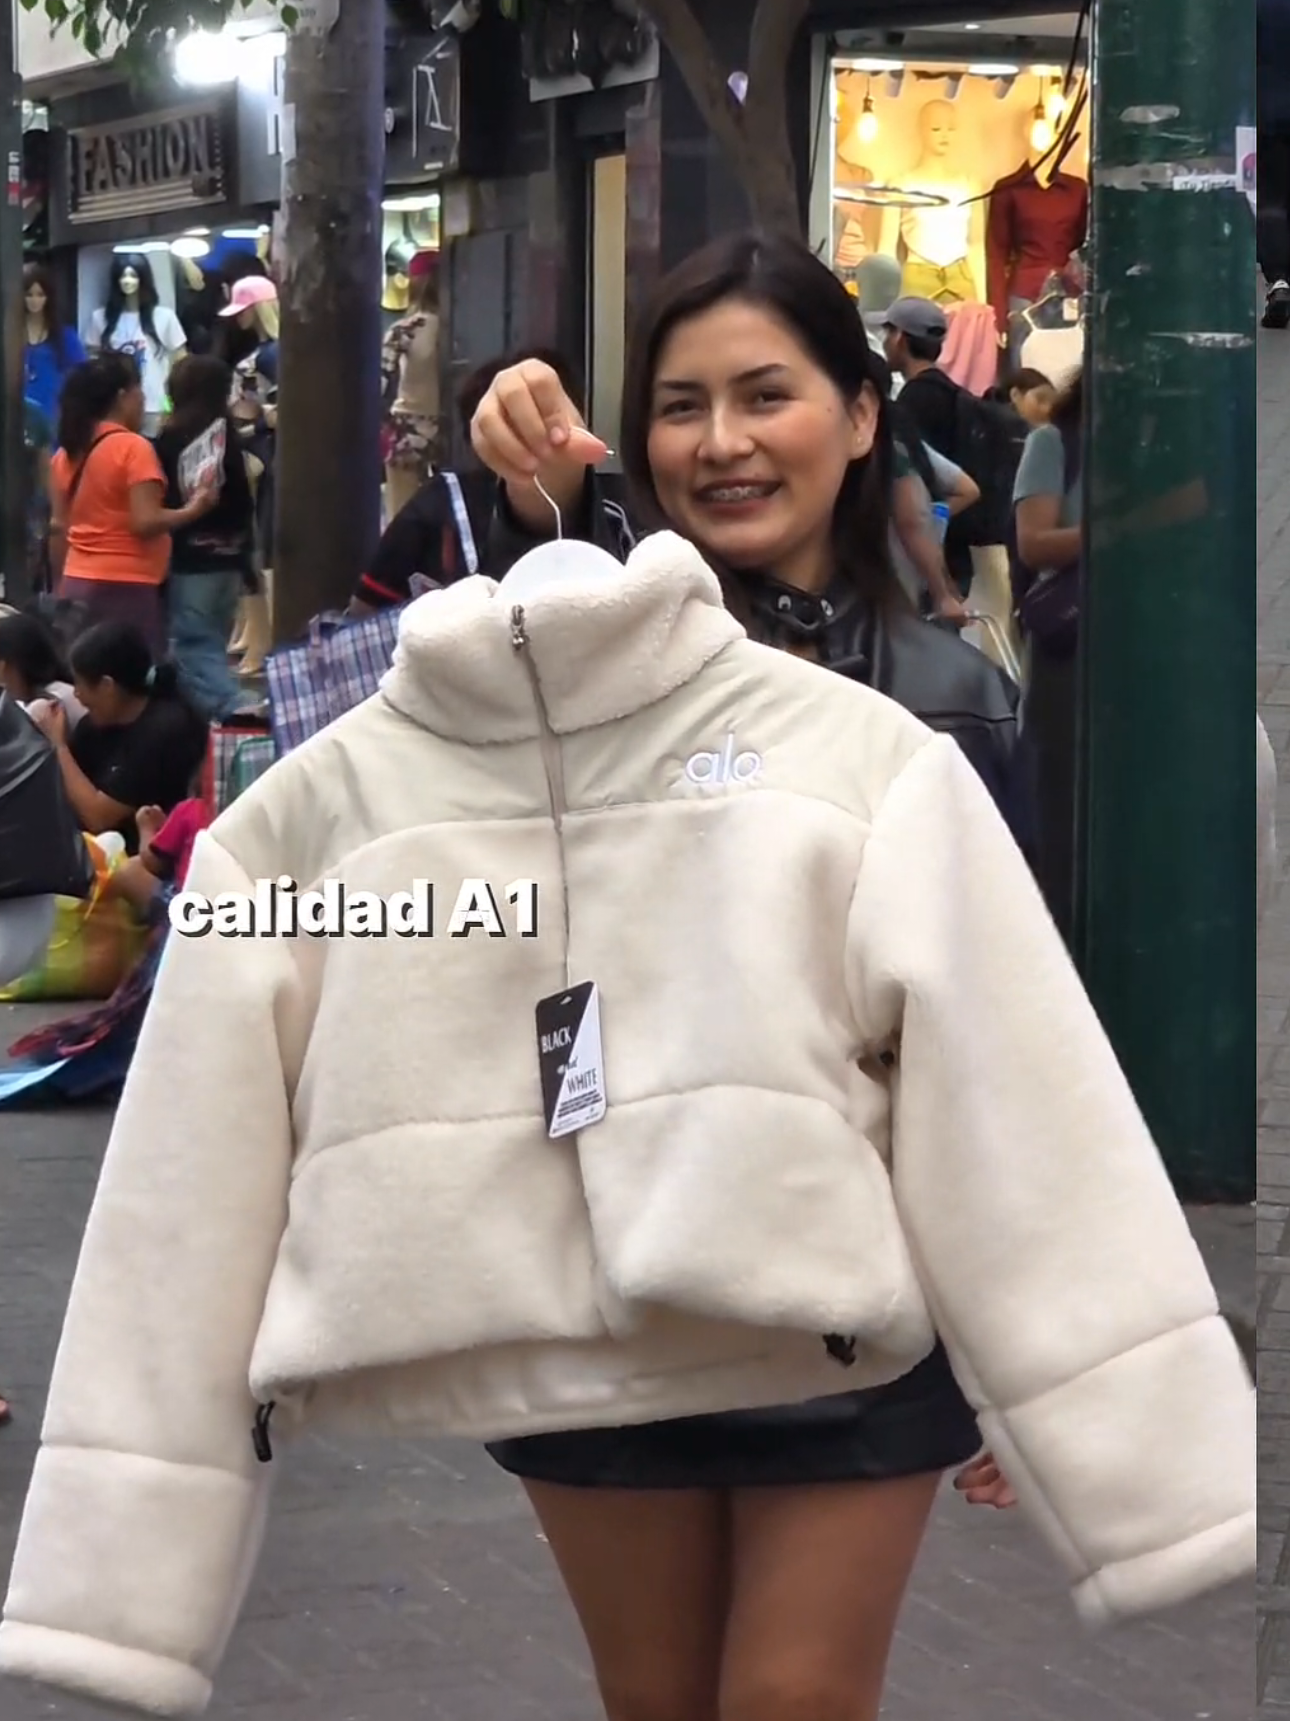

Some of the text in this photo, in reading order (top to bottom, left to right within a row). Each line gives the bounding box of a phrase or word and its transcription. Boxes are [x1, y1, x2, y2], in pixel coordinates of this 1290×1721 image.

[78, 116, 209, 193] FASHION
[685, 733, 761, 784] alo
[541, 1026, 572, 1054] BLACK
[567, 1068, 597, 1094] WHITE
